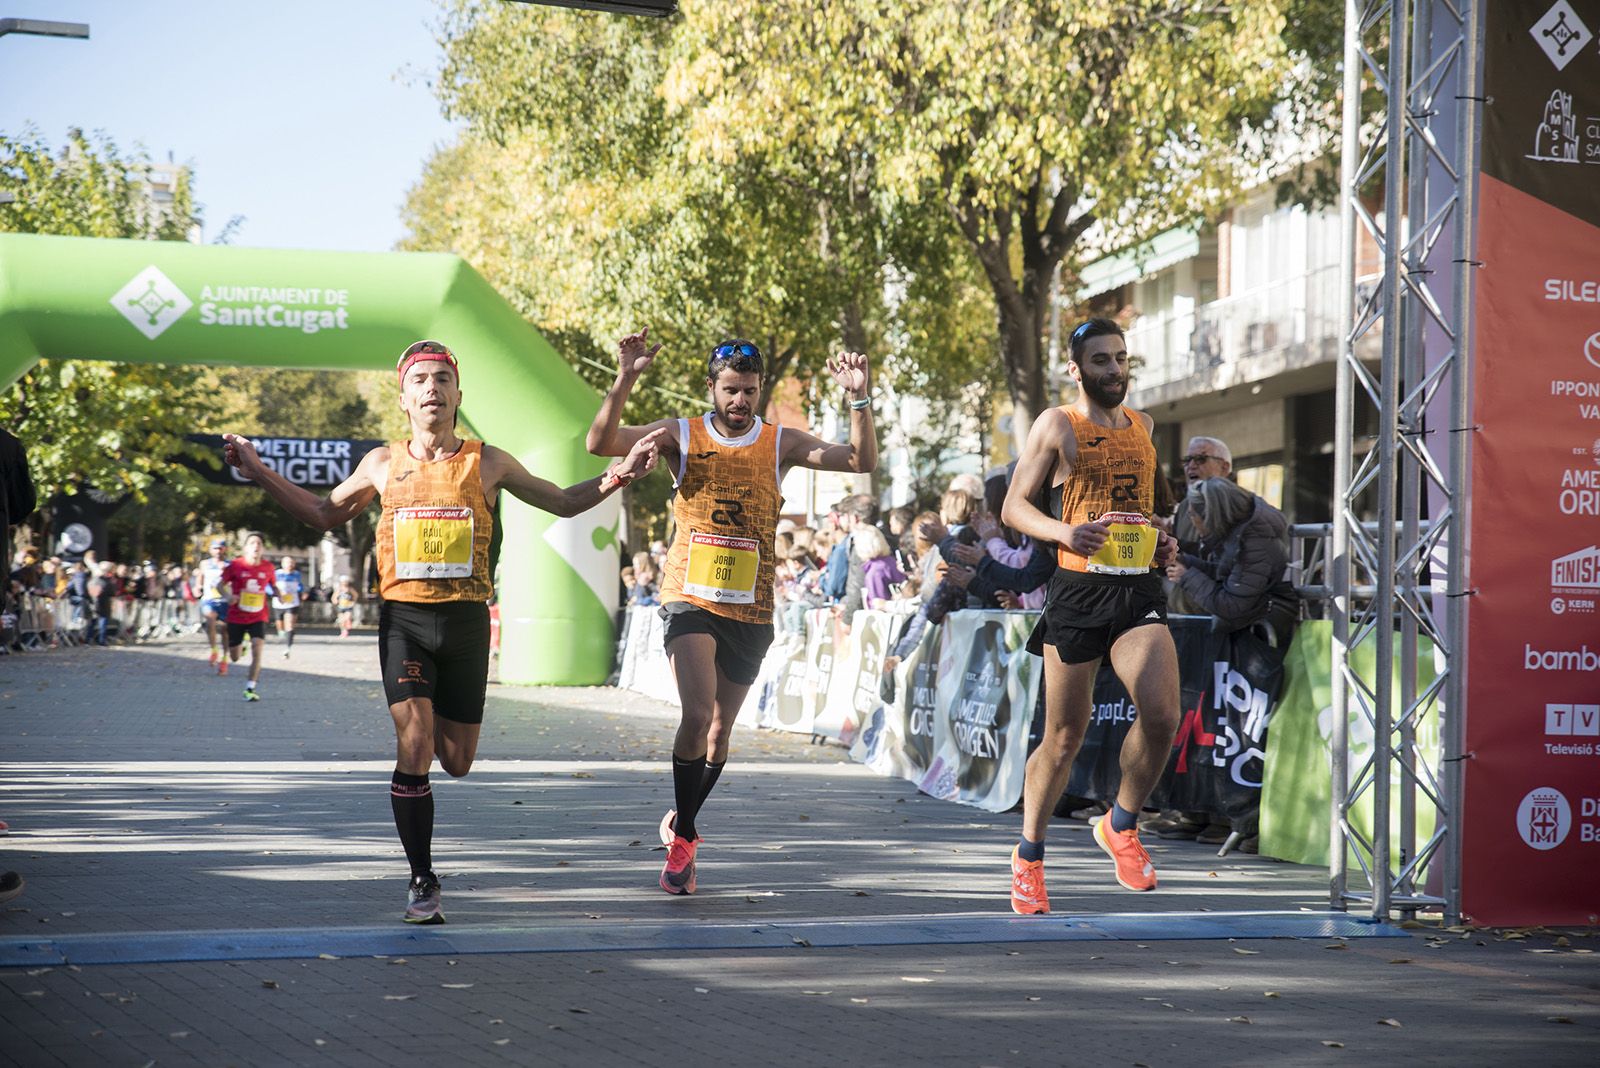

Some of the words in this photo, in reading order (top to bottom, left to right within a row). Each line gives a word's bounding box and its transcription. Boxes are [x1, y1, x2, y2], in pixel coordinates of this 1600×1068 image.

[200, 286, 320, 305] AJUNTAMENT
[325, 289, 348, 306] DE
[1545, 279, 1600, 302] SILE
[200, 302, 348, 333] SantCugat
[1551, 380, 1600, 398] IPPON
[250, 438, 351, 459] METLLER
[423, 541, 443, 555] 800
[1118, 545, 1134, 559] 799
[713, 555, 736, 566] JORDI
[715, 567, 732, 581] 801
[1524, 643, 1600, 671] bamb
[1544, 743, 1593, 755] Televisió
